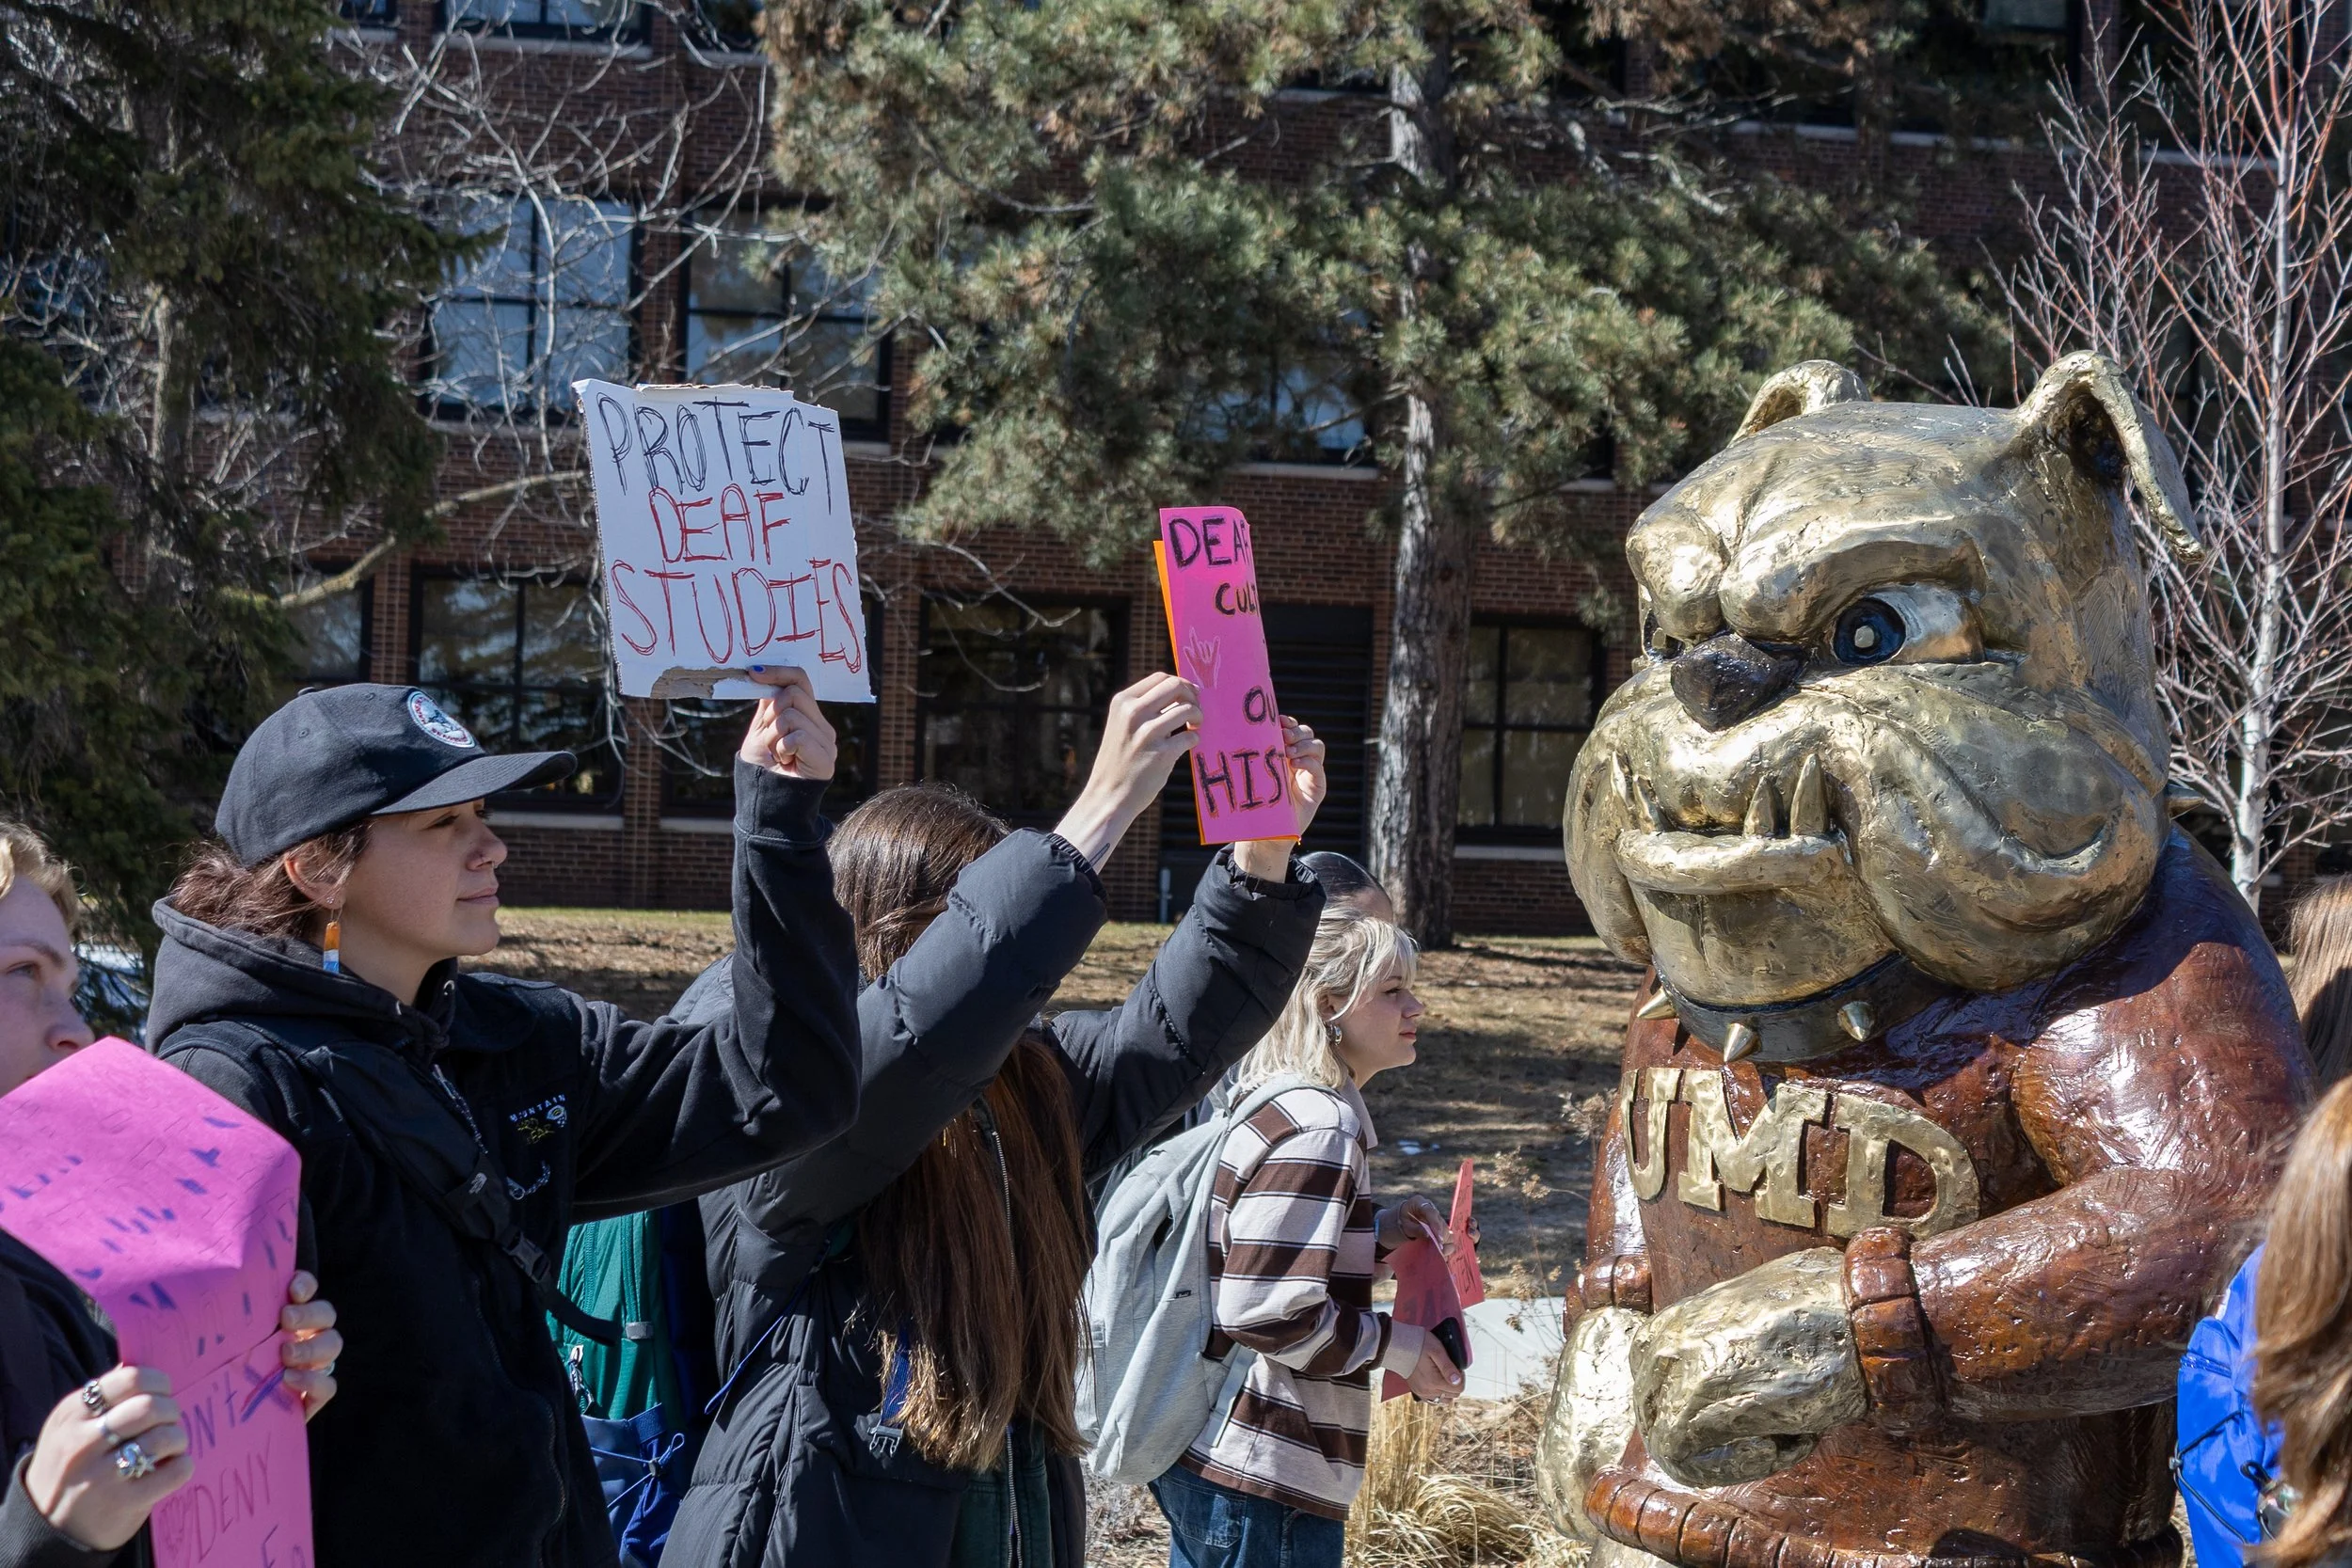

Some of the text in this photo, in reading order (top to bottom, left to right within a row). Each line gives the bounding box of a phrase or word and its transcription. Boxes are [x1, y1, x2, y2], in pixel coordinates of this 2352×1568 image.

[596, 391, 835, 515] PROTECT
[648, 483, 792, 564] DEAF
[612, 557, 862, 673] STUDIES
[1621, 1066, 1980, 1241] UMD
[193, 1431, 272, 1563] DENY
